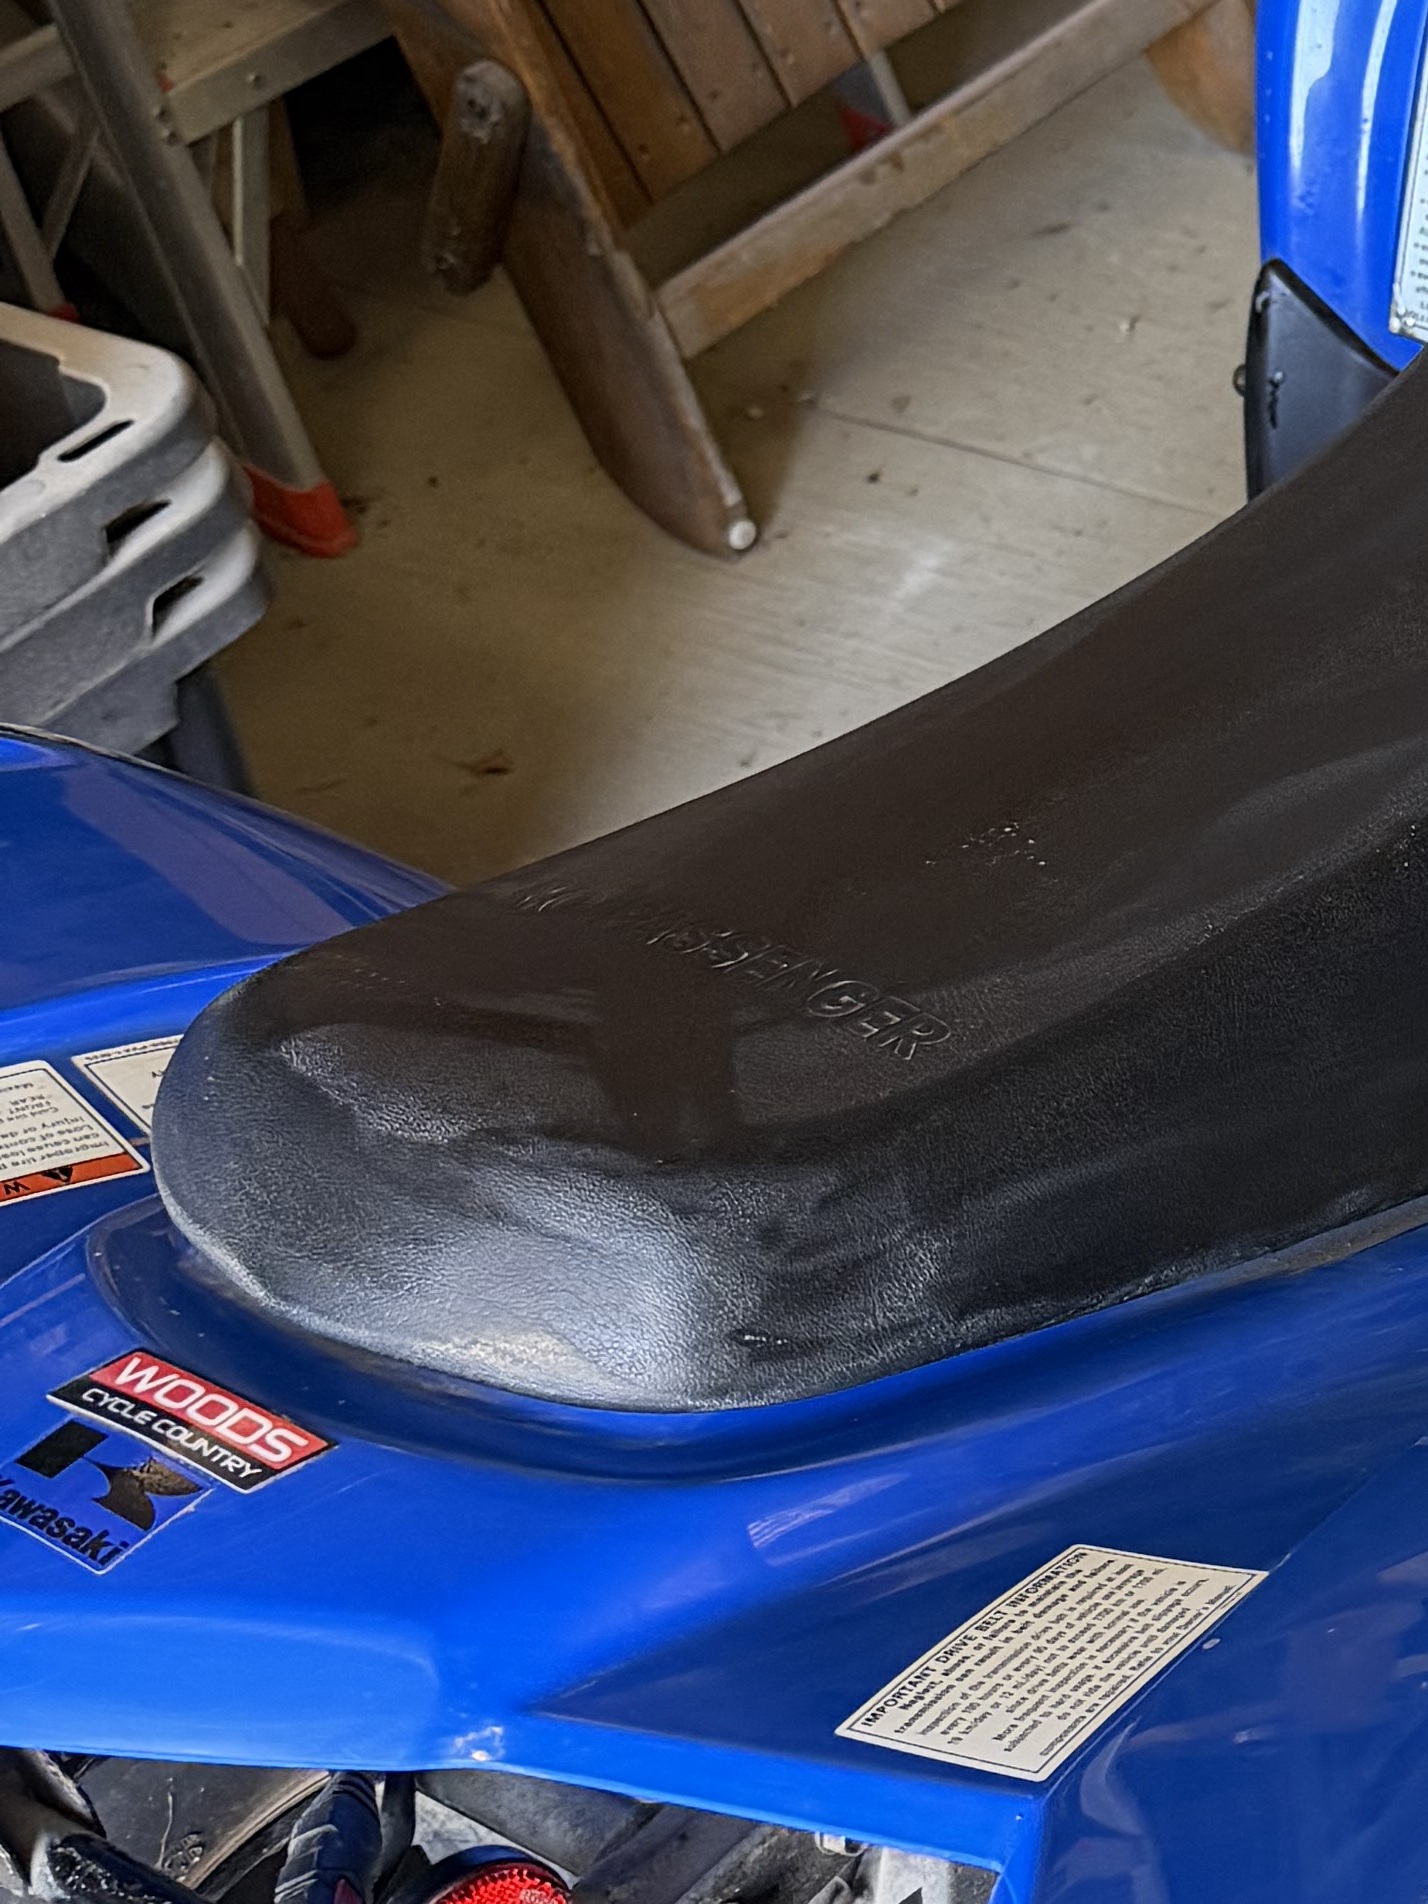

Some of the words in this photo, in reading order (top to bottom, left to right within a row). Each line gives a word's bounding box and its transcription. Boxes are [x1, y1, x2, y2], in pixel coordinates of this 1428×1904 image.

[81, 1387, 158, 1426] CYCLE
[151, 1417, 263, 1480] COUNTRY
[114, 1356, 310, 1463] WOODS
[855, 1666, 936, 1726] IMPORTANT
[935, 1634, 978, 1664] DRIVE
[974, 1610, 1008, 1632] BELT
[1006, 1550, 1087, 1607] INFORMATION
